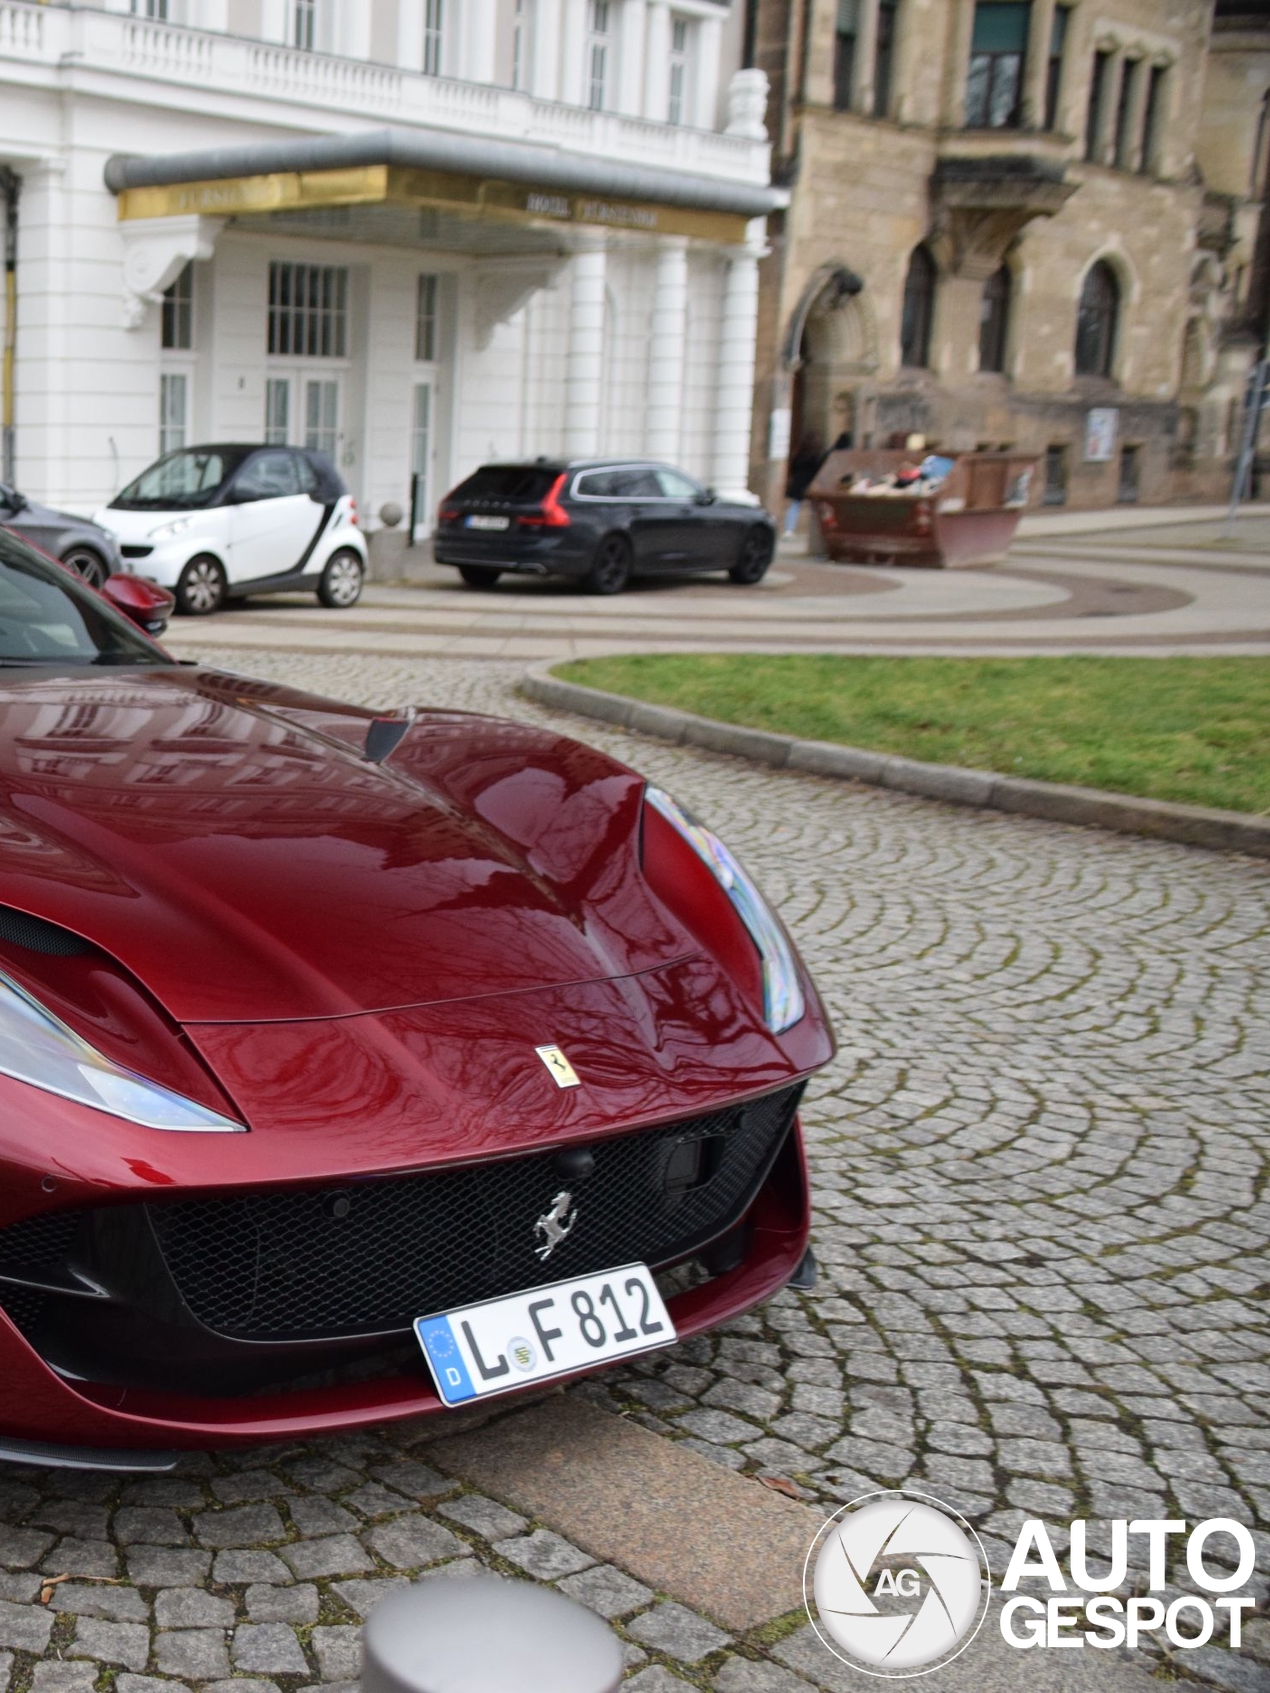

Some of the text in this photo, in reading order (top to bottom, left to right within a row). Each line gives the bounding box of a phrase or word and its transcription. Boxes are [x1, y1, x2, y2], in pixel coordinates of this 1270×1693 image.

[461, 1277, 664, 1381] L F 812
[445, 1367, 462, 1387] D
